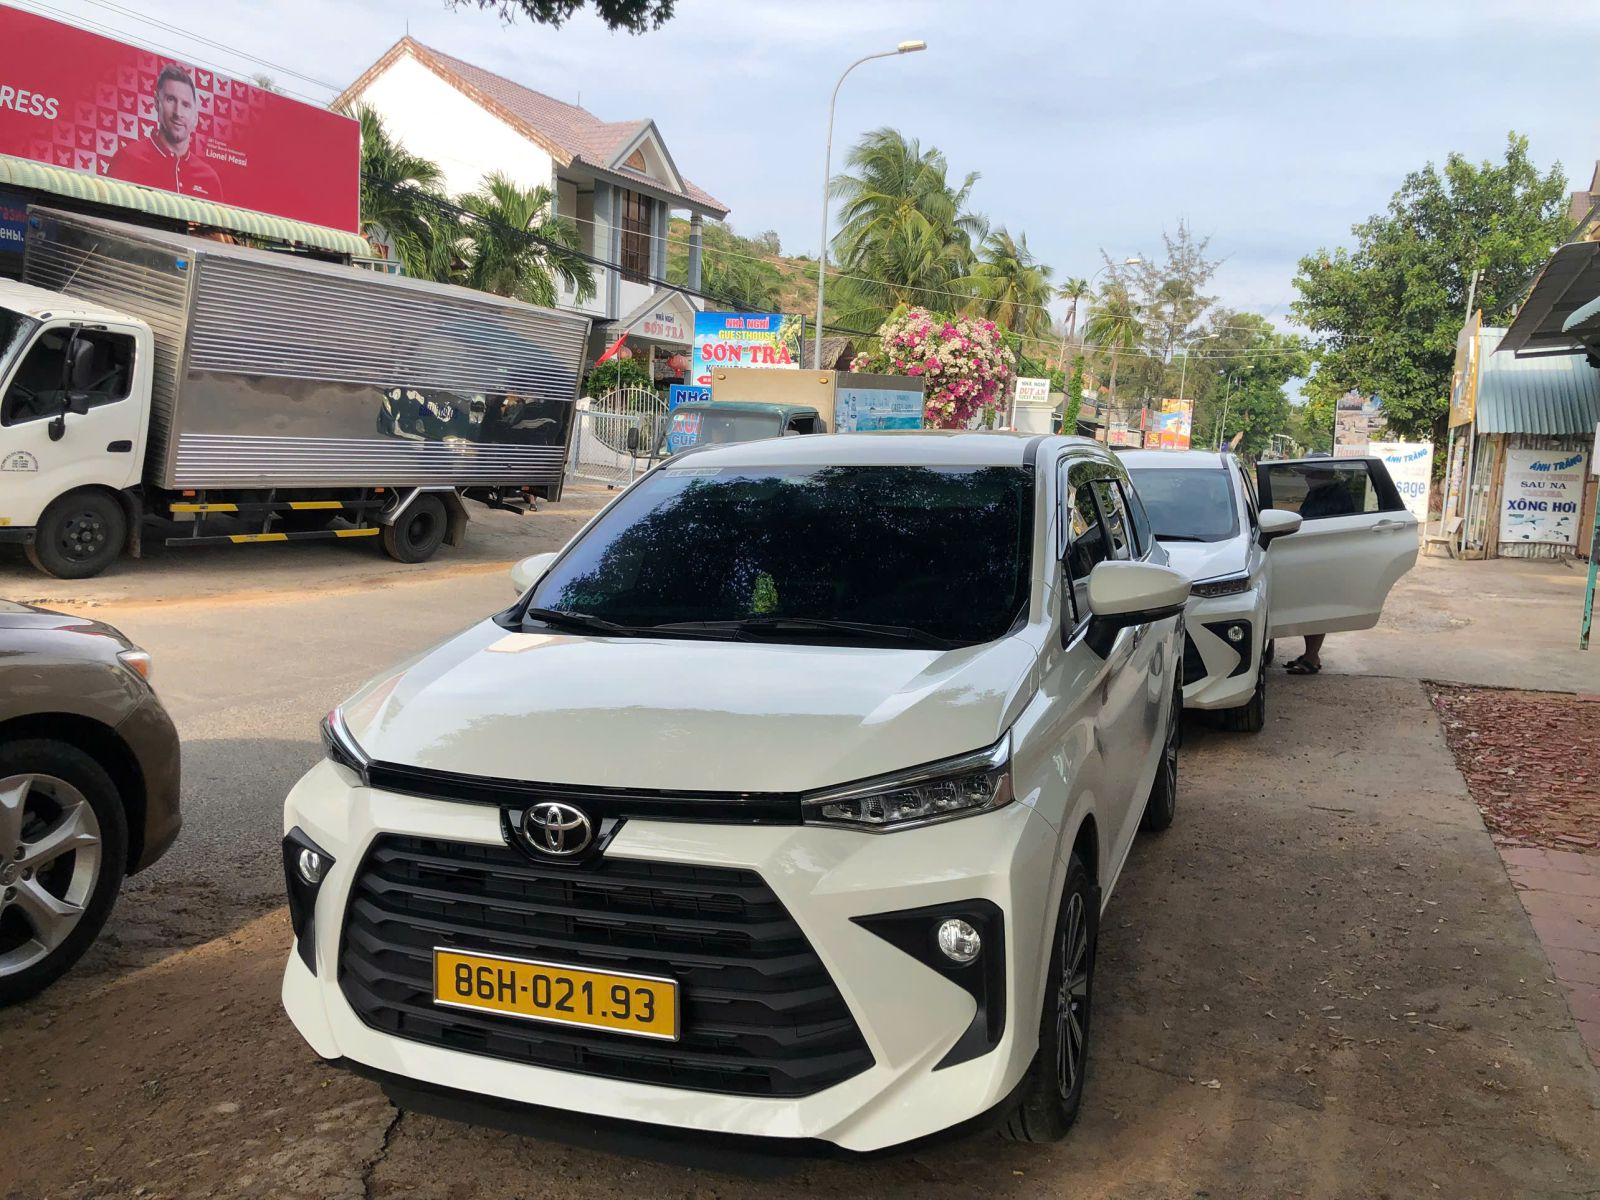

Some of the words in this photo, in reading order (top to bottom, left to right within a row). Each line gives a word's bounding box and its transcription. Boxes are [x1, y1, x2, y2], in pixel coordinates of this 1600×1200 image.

[0, 84, 59, 120] RESS
[206, 148, 227, 161] Lionel
[228, 154, 248, 167] Messi
[726, 316, 745, 329] NHÀ
[747, 316, 770, 330] NGHỈ
[719, 330, 776, 341] GUESTHOUSE
[701, 341, 742, 362] SƠN
[1396, 480, 1427, 499] sage
[1520, 480, 1546, 489] SAU
[1550, 482, 1567, 490] NA
[1507, 497, 1549, 512] XÔNG
[1551, 500, 1578, 514] HƠI
[455, 962, 655, 1024] 86H-021.93
